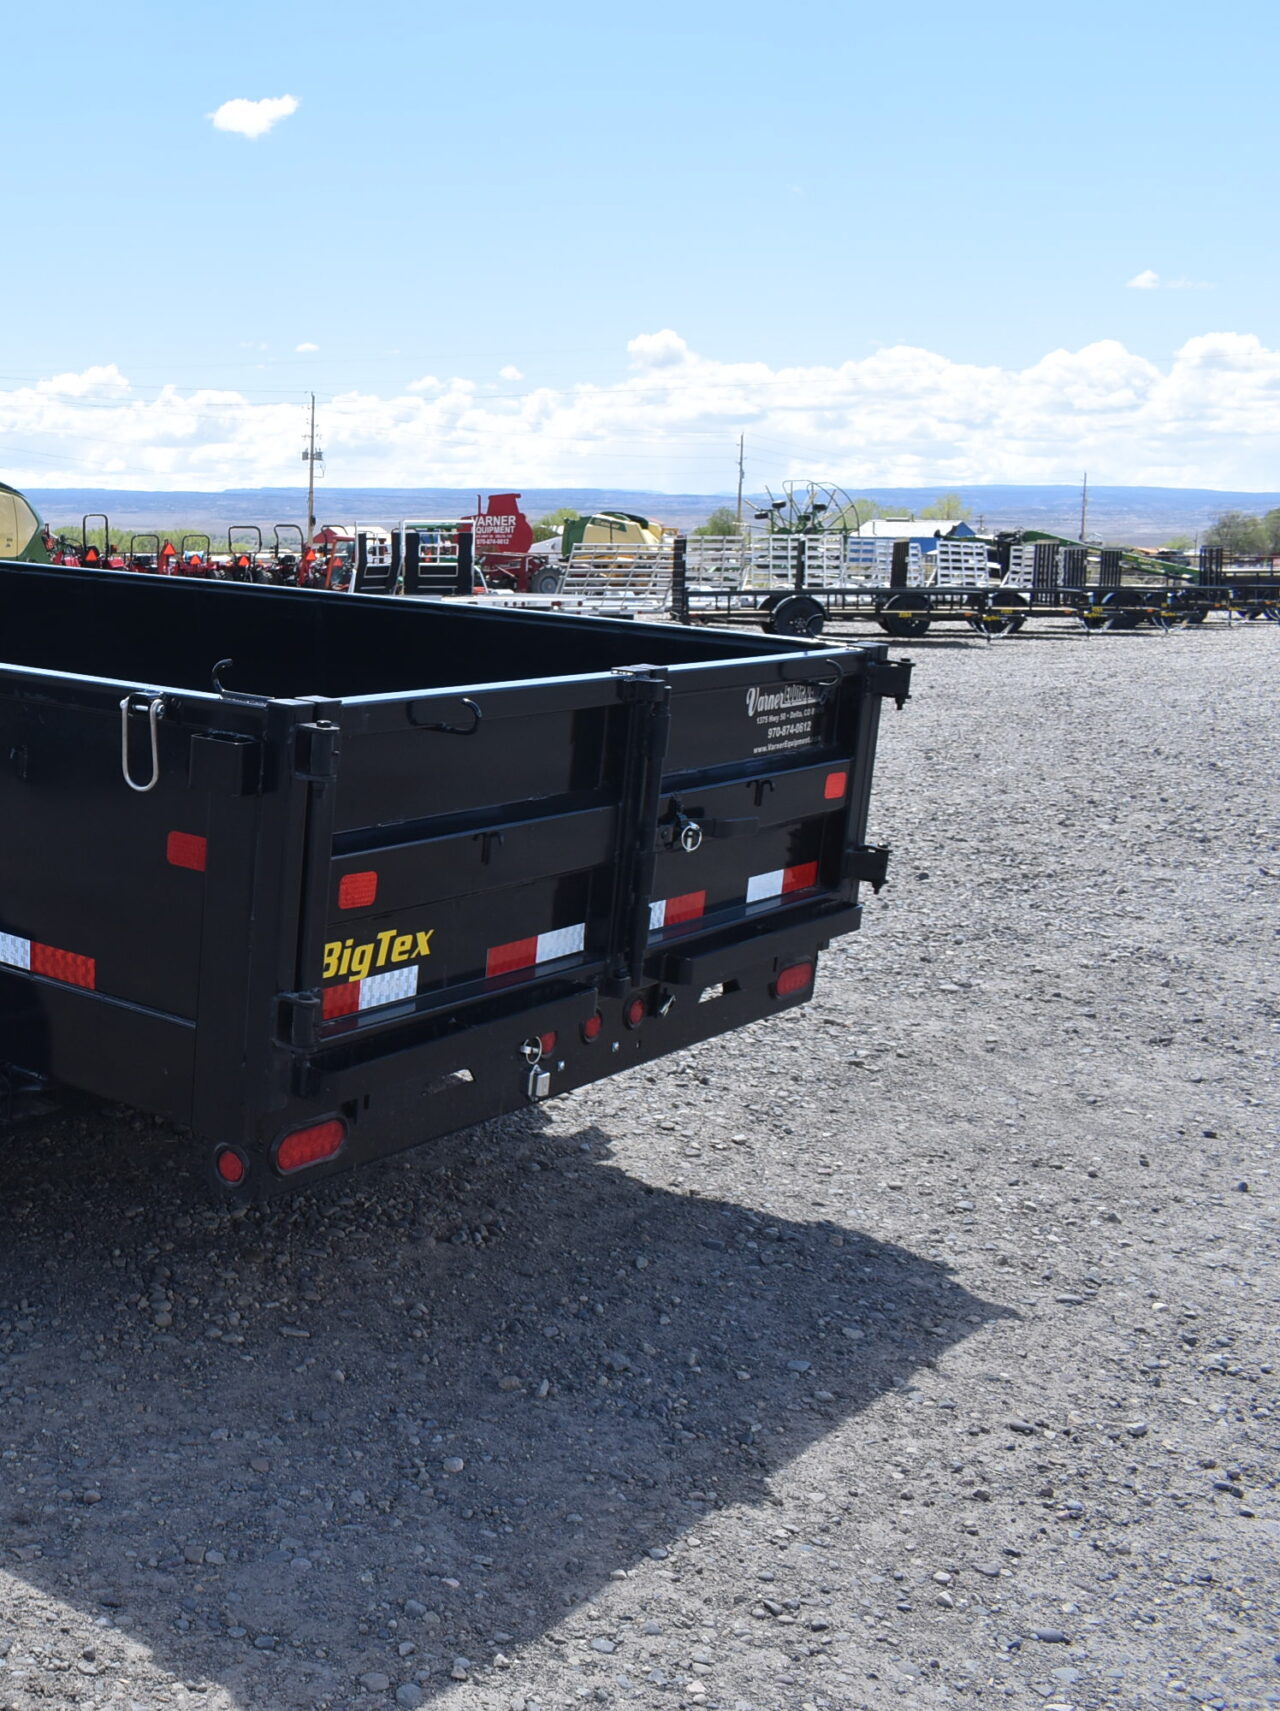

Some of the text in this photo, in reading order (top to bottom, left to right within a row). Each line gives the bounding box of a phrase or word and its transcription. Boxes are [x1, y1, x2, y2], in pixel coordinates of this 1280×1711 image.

[471, 515, 517, 526] VARNER
[472, 525, 515, 534] QUIPMENT
[746, 687, 784, 717] Varner
[767, 721, 812, 739] 970-874-0612
[753, 736, 818, 754] www.VarnerEquipment.
